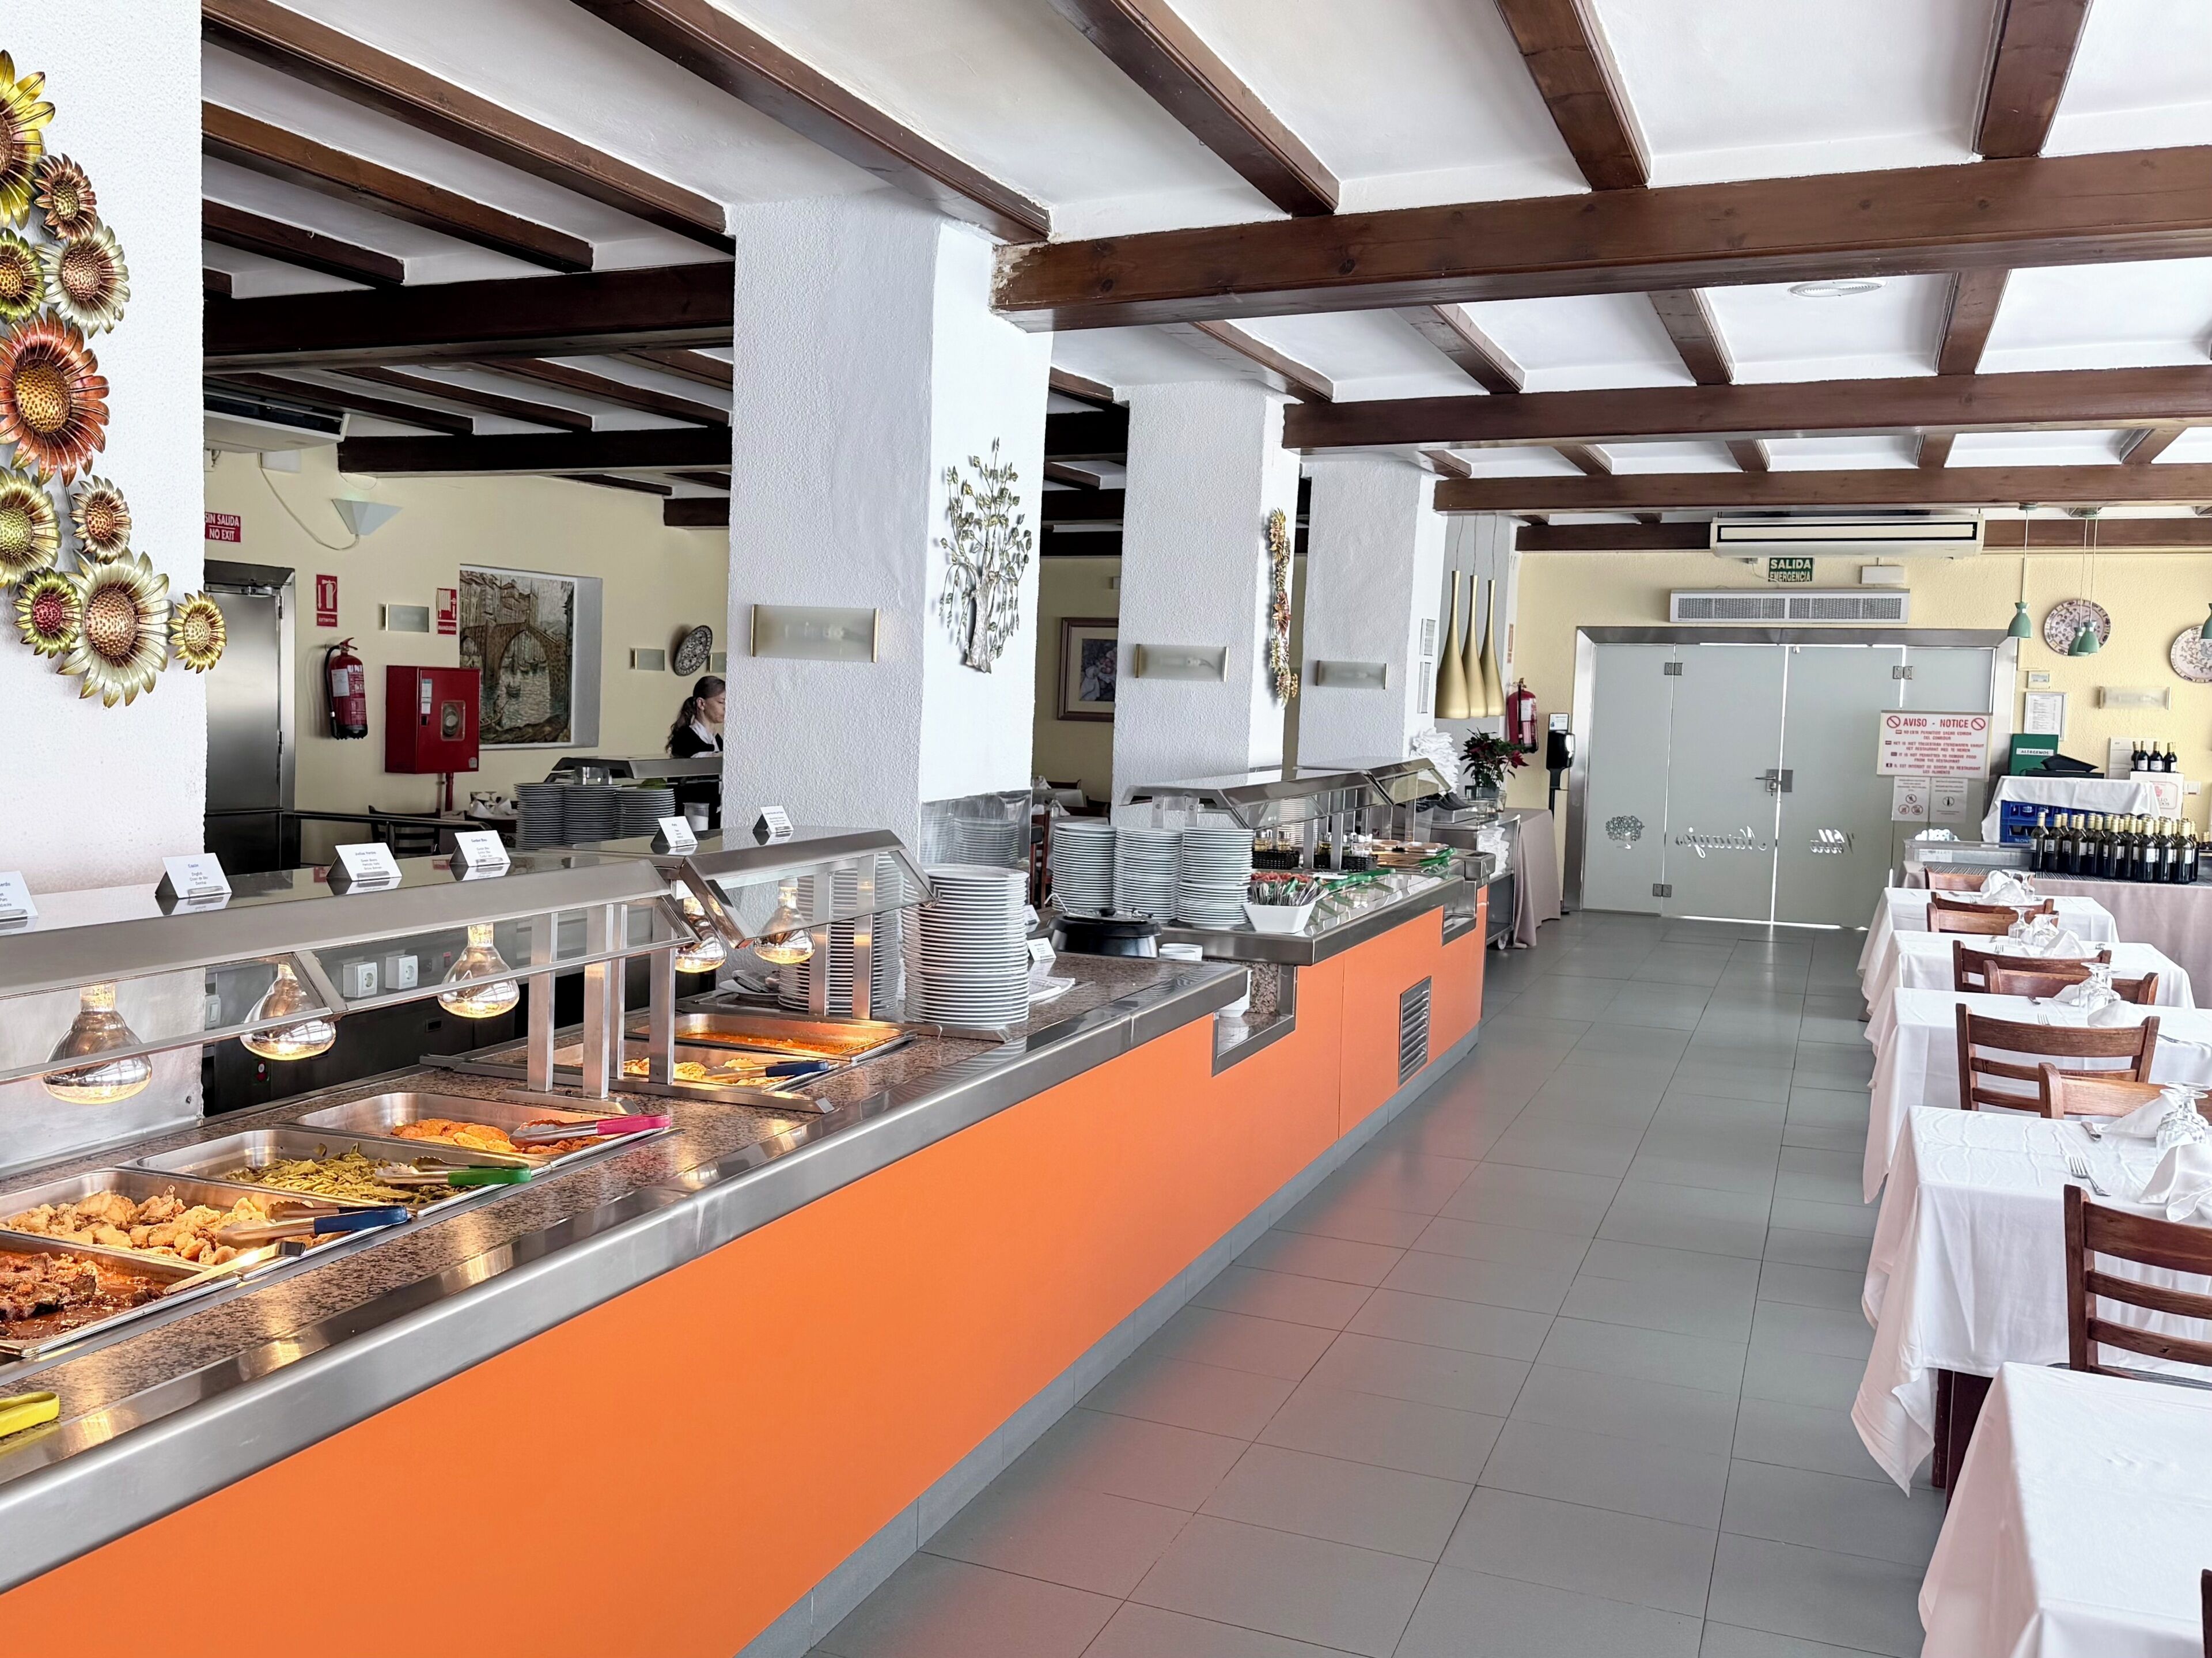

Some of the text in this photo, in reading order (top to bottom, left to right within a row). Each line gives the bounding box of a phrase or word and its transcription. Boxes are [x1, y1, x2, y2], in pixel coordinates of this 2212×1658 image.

[205, 513, 240, 527] SIN SALIDA
[209, 528, 235, 541] NO EXIT
[1770, 559, 1811, 569] SALIDA
[1770, 571, 1810, 582] EMERGENCIA
[1903, 718, 1927, 727] AVISO
[1940, 719, 1969, 728] NOTICE
